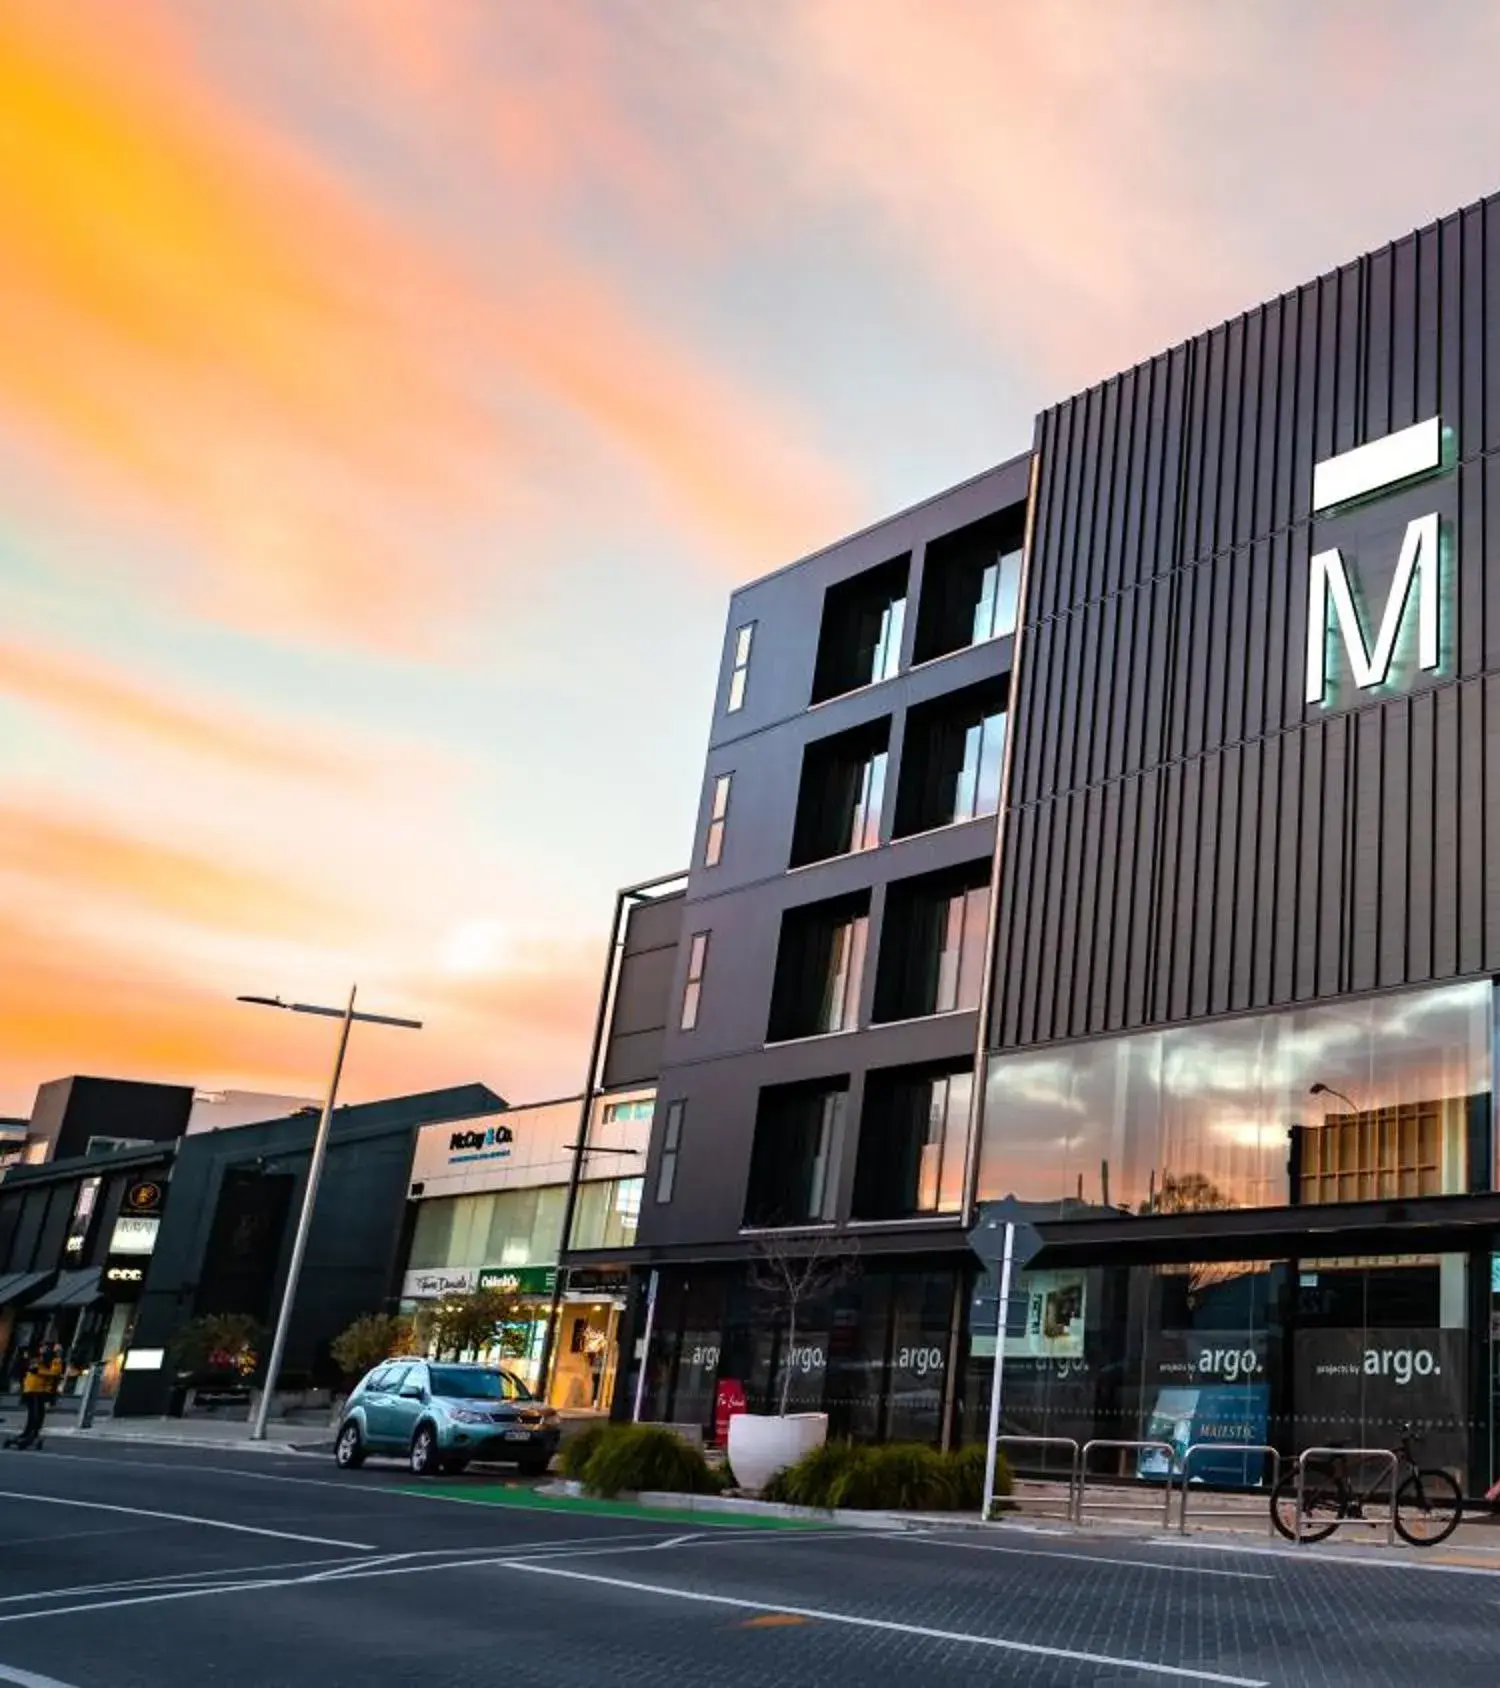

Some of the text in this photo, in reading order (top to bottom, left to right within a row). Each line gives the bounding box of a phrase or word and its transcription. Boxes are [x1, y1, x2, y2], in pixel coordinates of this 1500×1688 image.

[1306, 511, 1440, 705] M
[486, 1128, 494, 1145] &
[900, 1347, 944, 1375] argo.
[1200, 1349, 1263, 1380] argo.
[1363, 1349, 1441, 1384] argo.
